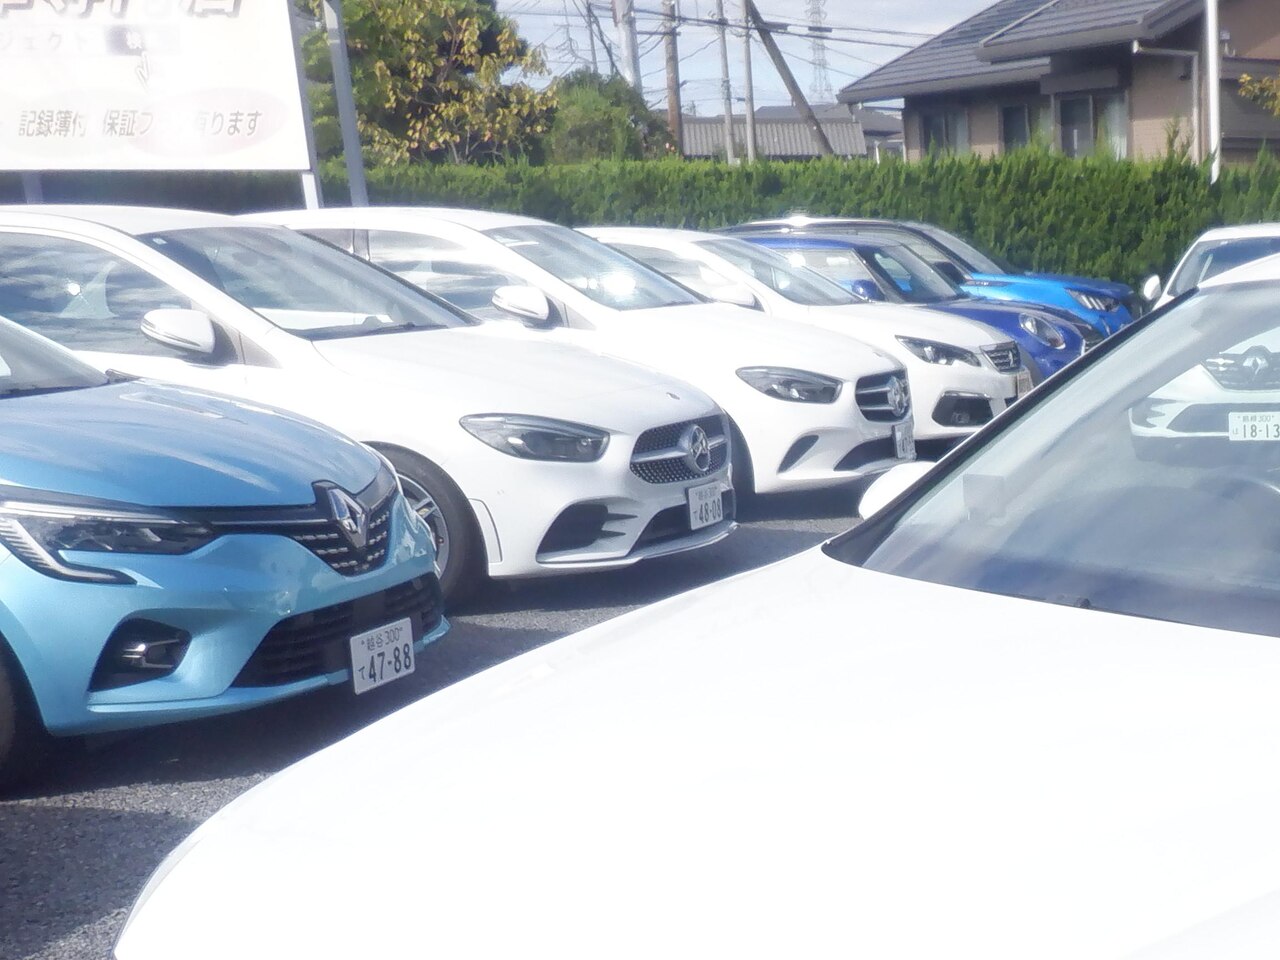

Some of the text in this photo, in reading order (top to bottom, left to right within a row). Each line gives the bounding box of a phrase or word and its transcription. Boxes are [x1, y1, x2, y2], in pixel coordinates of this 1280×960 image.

[1243, 423, 1280, 438] 18-13
[699, 498, 722, 524] 48-08
[384, 627, 400, 646] 300
[358, 643, 412, 683] て 47-88
